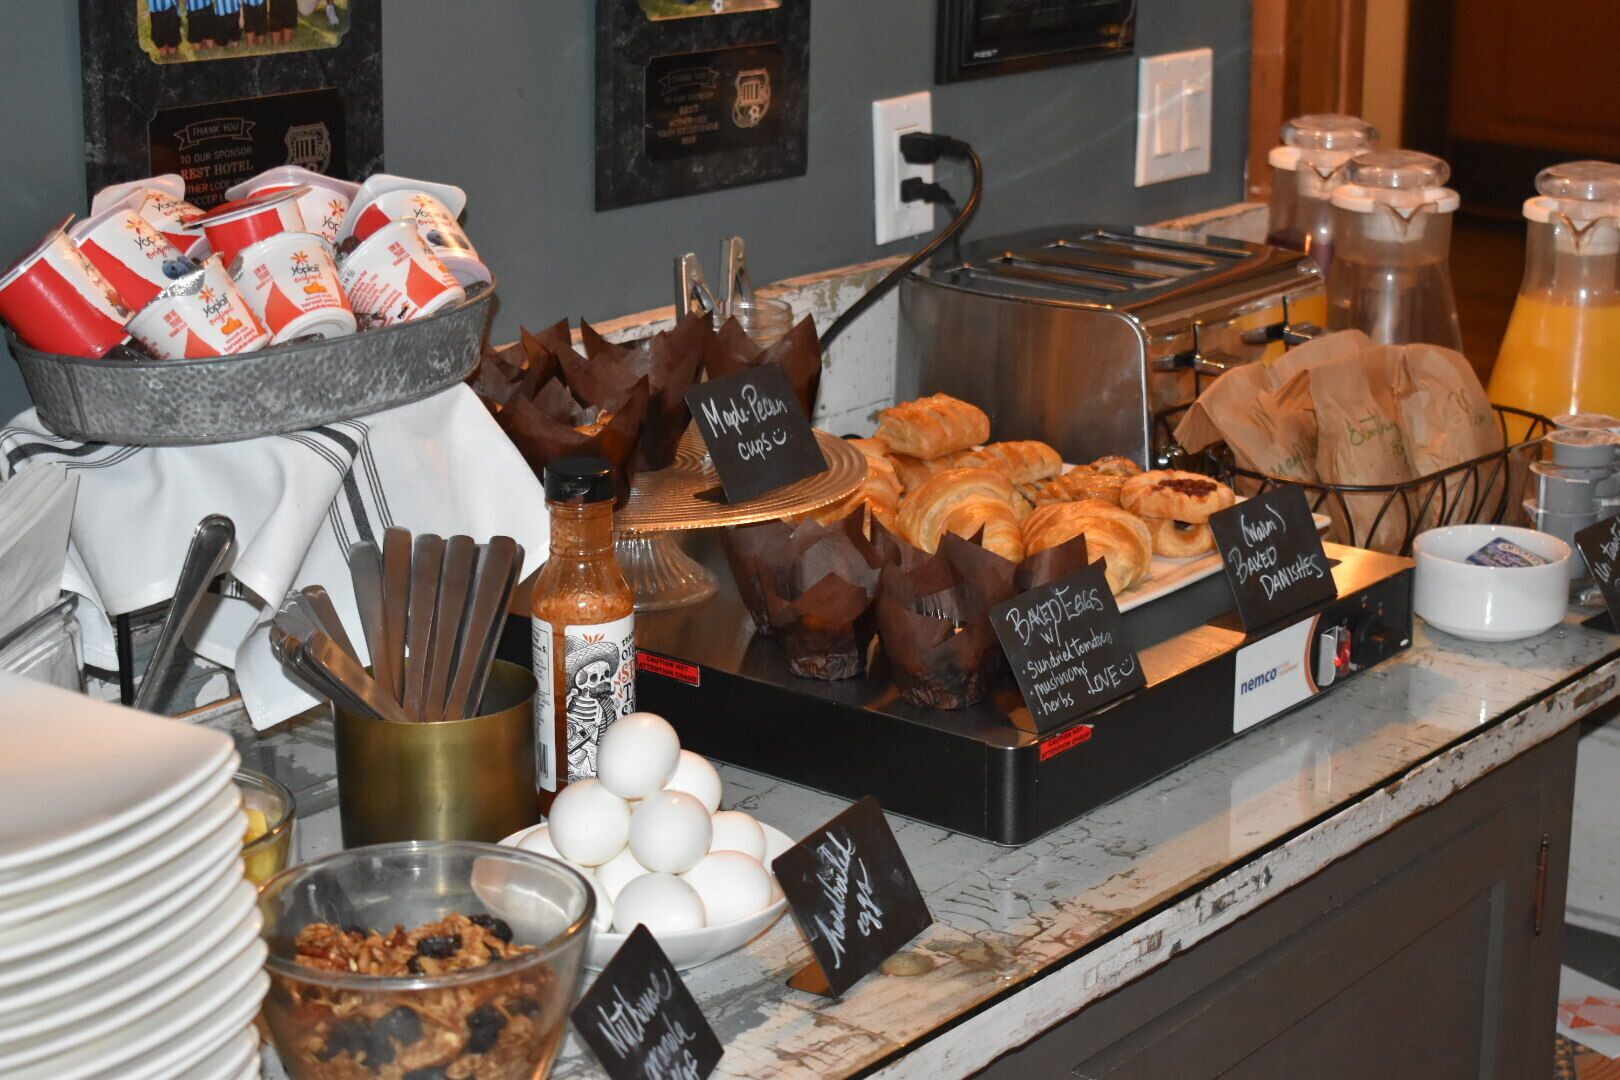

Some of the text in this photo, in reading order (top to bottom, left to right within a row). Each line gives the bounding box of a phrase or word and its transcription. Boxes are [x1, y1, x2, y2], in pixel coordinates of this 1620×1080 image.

[192, 122, 240, 137] THANK YOU
[181, 146, 253, 165] TO OUR SPONSOR
[181, 160, 254, 180] REST HOTEL
[186, 183, 209, 194] THER
[738, 432, 773, 461] cups
[1228, 546, 1278, 585] BAKED
[1259, 553, 1324, 601] DANISHES
[638, 662, 674, 676] ATTENTION
[646, 656, 674, 668] CAUTION
[1240, 667, 1277, 695] nemco
[1039, 692, 1075, 716] herbs
